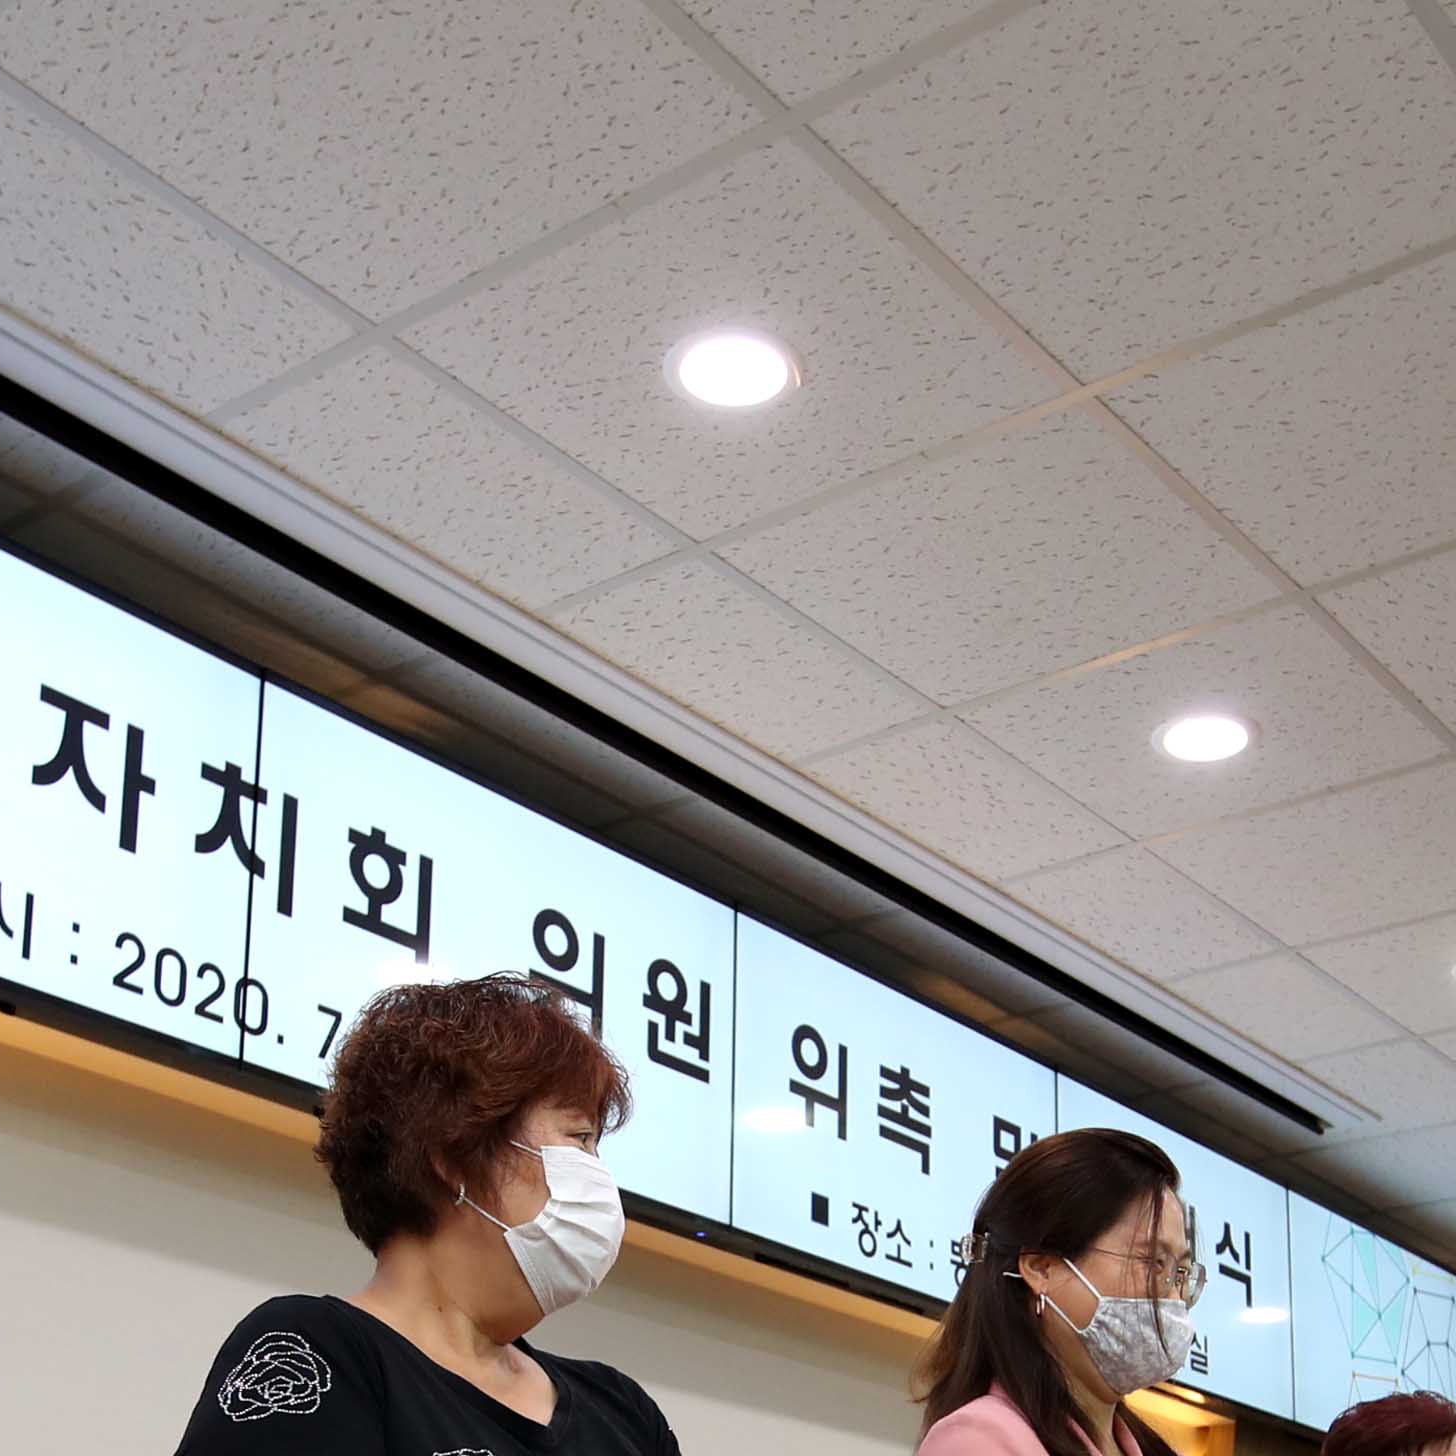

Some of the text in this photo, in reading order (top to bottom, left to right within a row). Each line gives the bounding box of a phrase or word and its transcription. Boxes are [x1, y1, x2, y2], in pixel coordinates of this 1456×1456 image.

[112, 932, 284, 1045] 2020.
[528, 908, 711, 1084] 위원
[789, 1024, 932, 1175] 위촉
[850, 1201, 913, 1268] 장소
